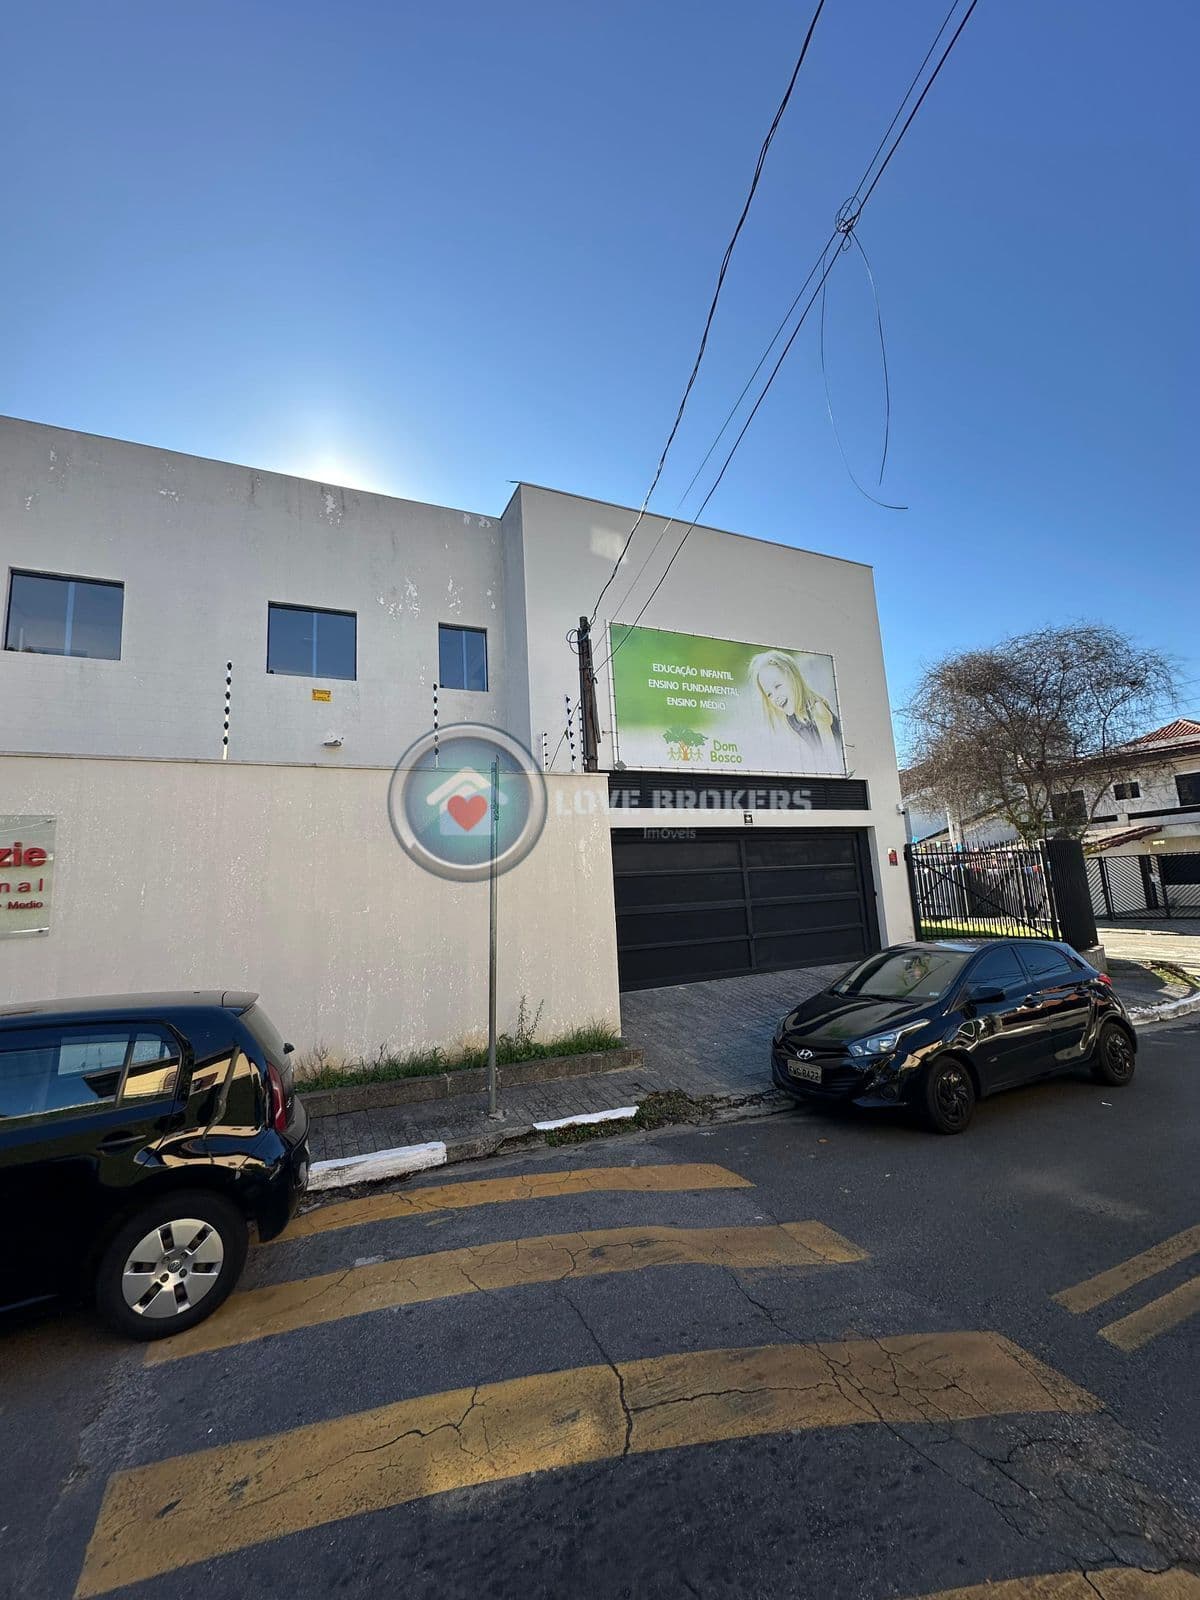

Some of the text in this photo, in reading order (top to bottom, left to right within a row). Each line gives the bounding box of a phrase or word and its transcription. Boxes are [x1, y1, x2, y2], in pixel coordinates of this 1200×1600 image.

[652, 663, 734, 680] EDUCAÇÃO INFANTIL
[648, 678, 740, 697] ENSINO FUNDAMENTAL
[666, 696, 697, 708] ENSINO
[713, 739, 738, 752] Dom
[710, 750, 742, 763] Bosco
